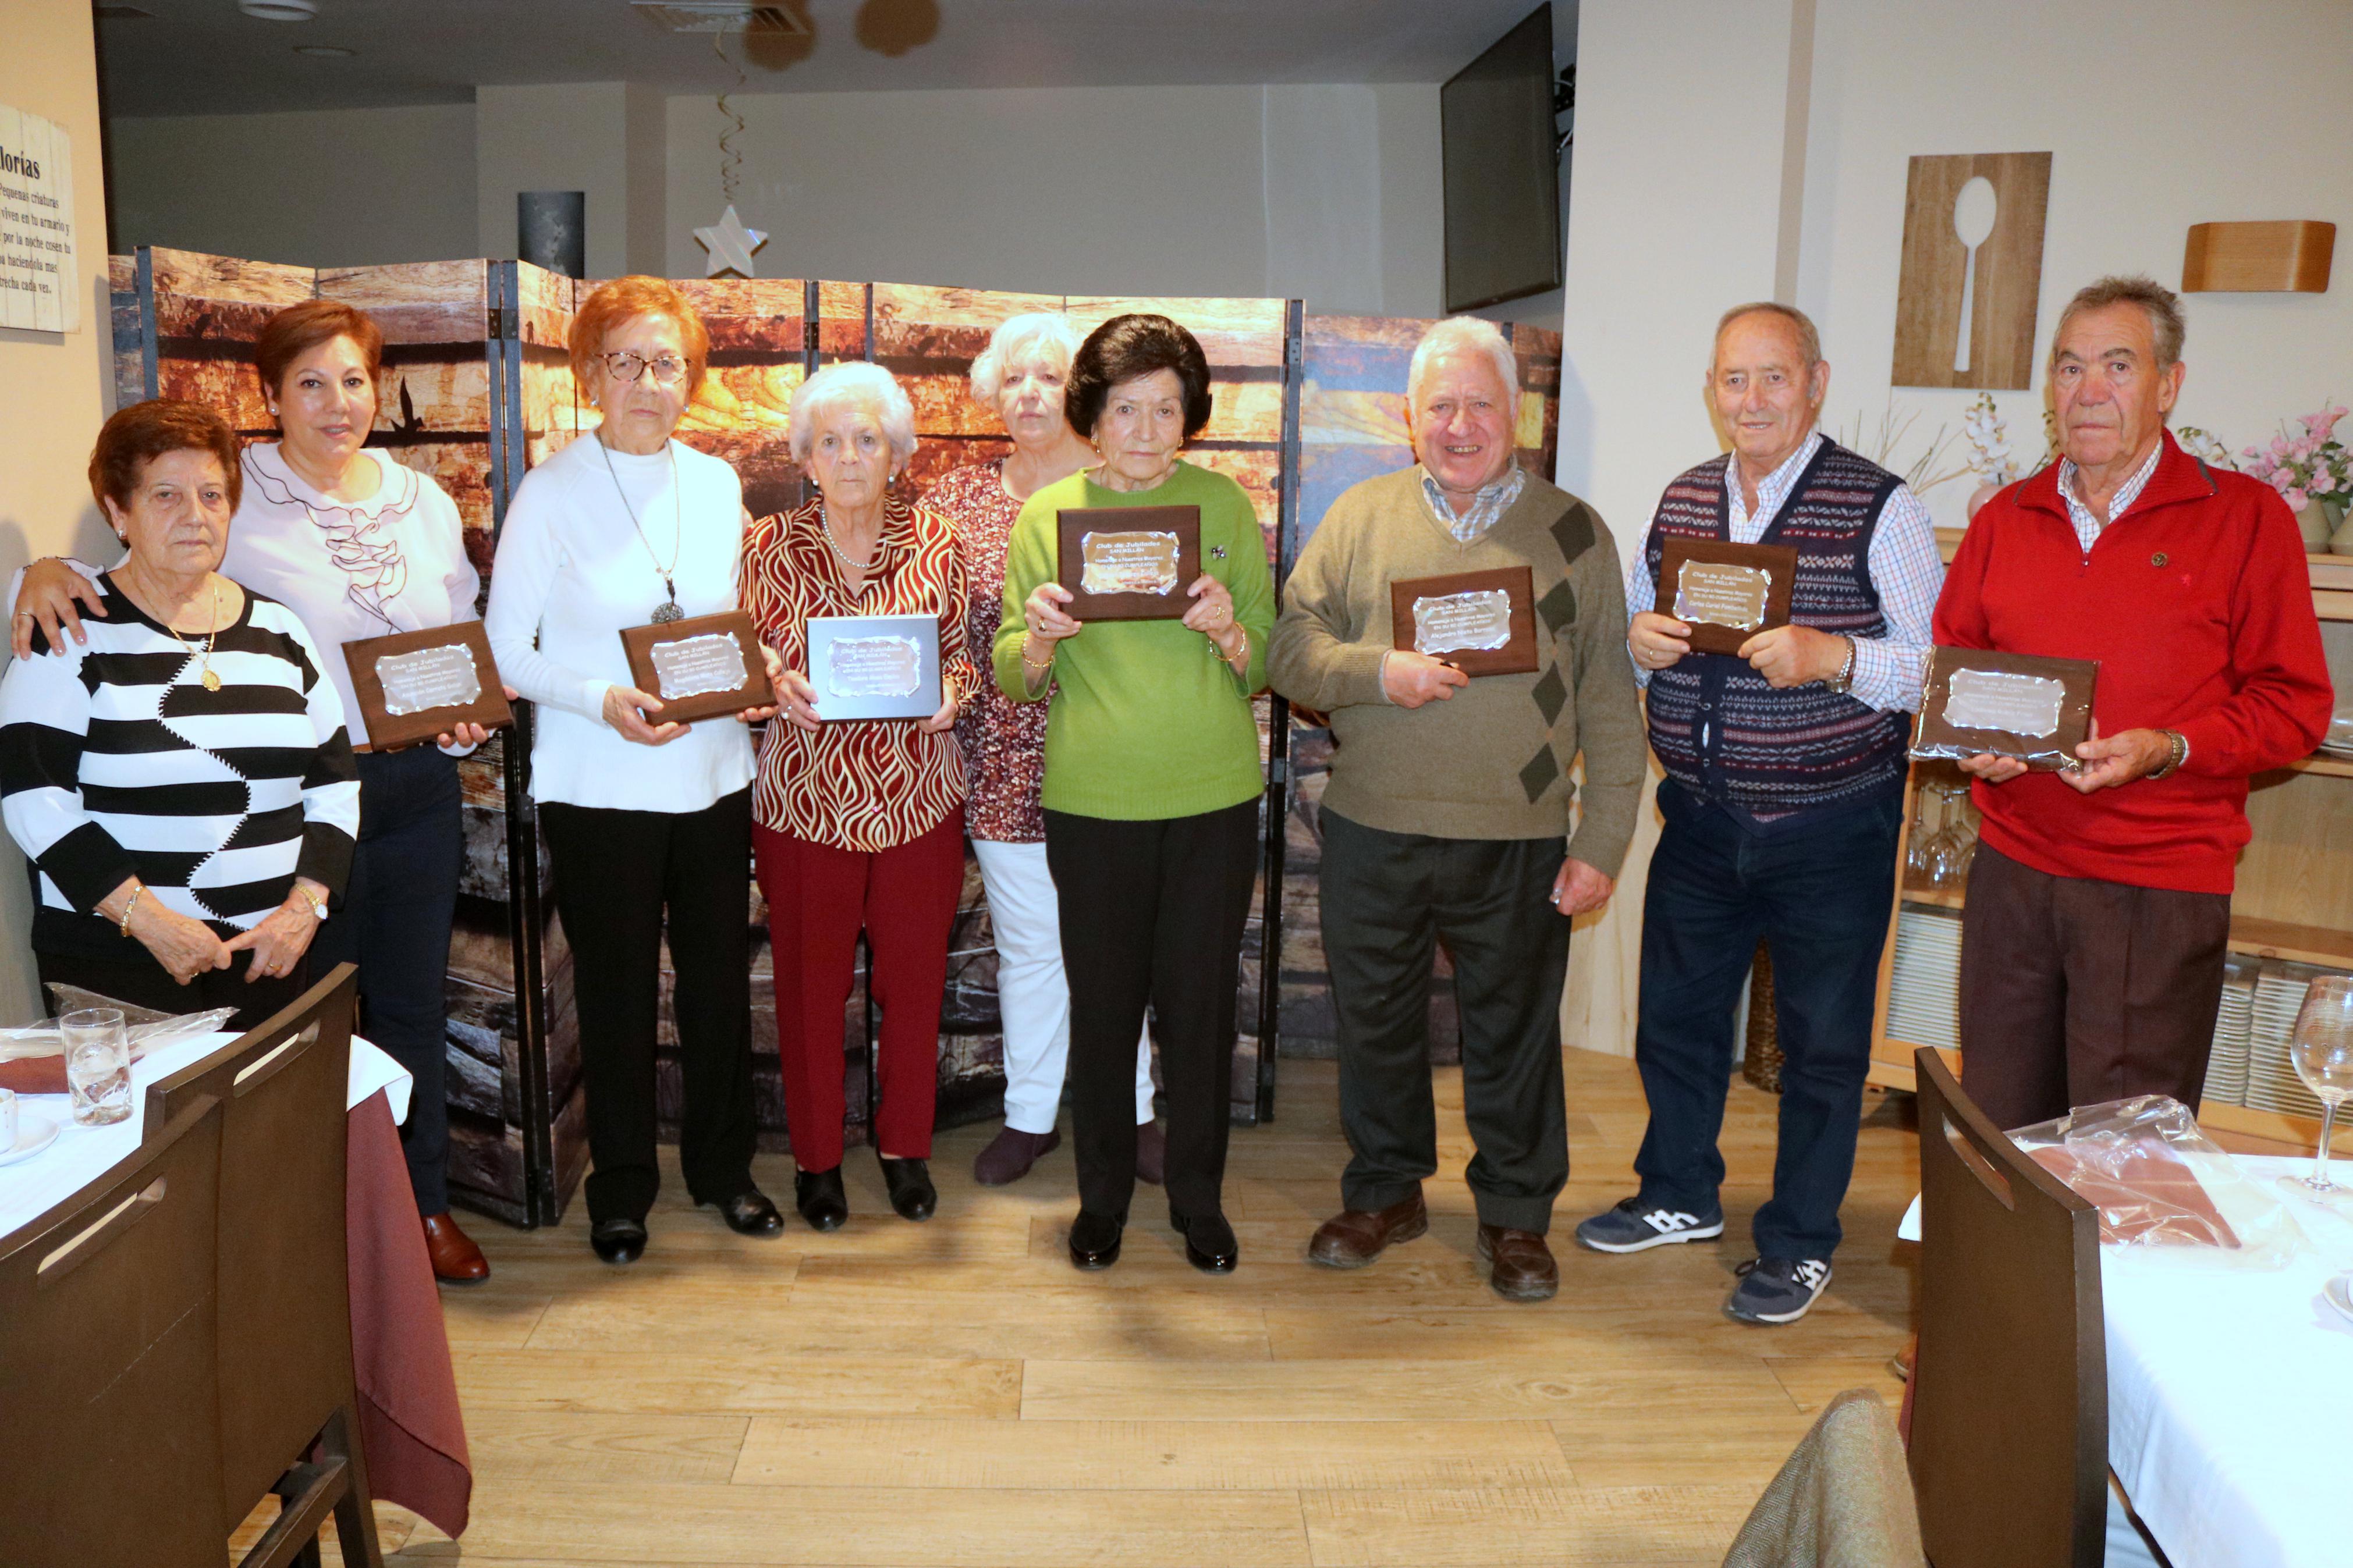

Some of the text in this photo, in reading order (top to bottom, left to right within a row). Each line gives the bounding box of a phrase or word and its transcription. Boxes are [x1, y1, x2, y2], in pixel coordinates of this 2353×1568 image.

[0, 145, 40, 179] lorías
[31, 192, 59, 209] criaturas
[1, 207, 69, 236] viven en tu armario y
[3, 233, 13, 244] por
[16, 232, 23, 245] la
[25, 236, 43, 249] noche
[46, 241, 62, 253] cosen
[65, 242, 70, 254] tu
[22, 279, 37, 291] cada
